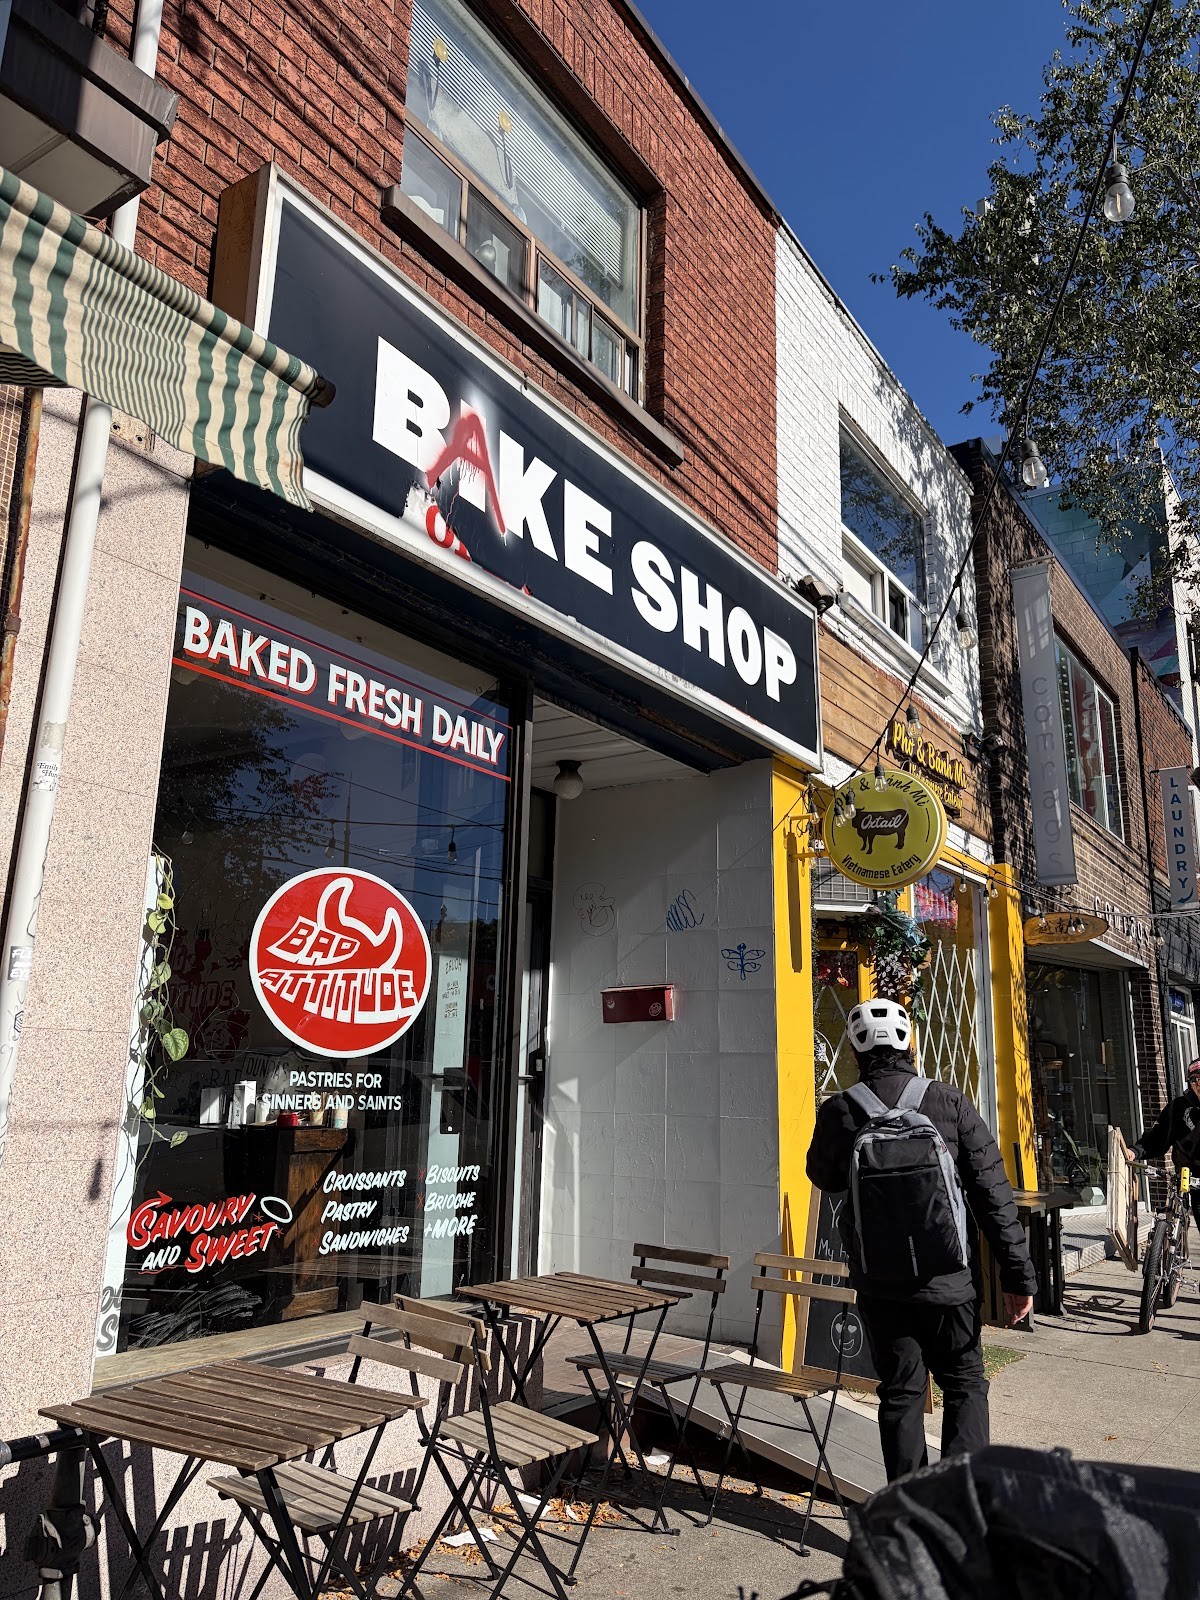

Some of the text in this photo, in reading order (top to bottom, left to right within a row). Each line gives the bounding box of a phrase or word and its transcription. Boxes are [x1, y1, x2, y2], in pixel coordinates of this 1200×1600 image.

[372, 335, 797, 702] BAKE SHOP
[183, 605, 506, 766] BAKED FRESH DAILY
[859, 777, 870, 791] &
[885, 775, 913, 792] ánh
[861, 813, 904, 830] Oxtail
[1170, 777, 1188, 889] LAUNDRY
[841, 854, 922, 879] Vietnamese Eatery
[266, 915, 361, 966] BAD
[256, 967, 419, 1024] ATTITUDE
[289, 1070, 383, 1089] PASTRIES FOR
[261, 1093, 321, 1111] SINNERS
[325, 1094, 355, 1111] AND
[358, 1095, 402, 1111] SAINTS
[323, 1164, 480, 1194] CROISSANTS BISCUITS
[126, 1191, 257, 1250] SAVOURY
[320, 1191, 477, 1224] PASTRY BRIOCHE
[141, 1221, 278, 1273] AND SWEET
[318, 1226, 410, 1255] SANDWICHES
